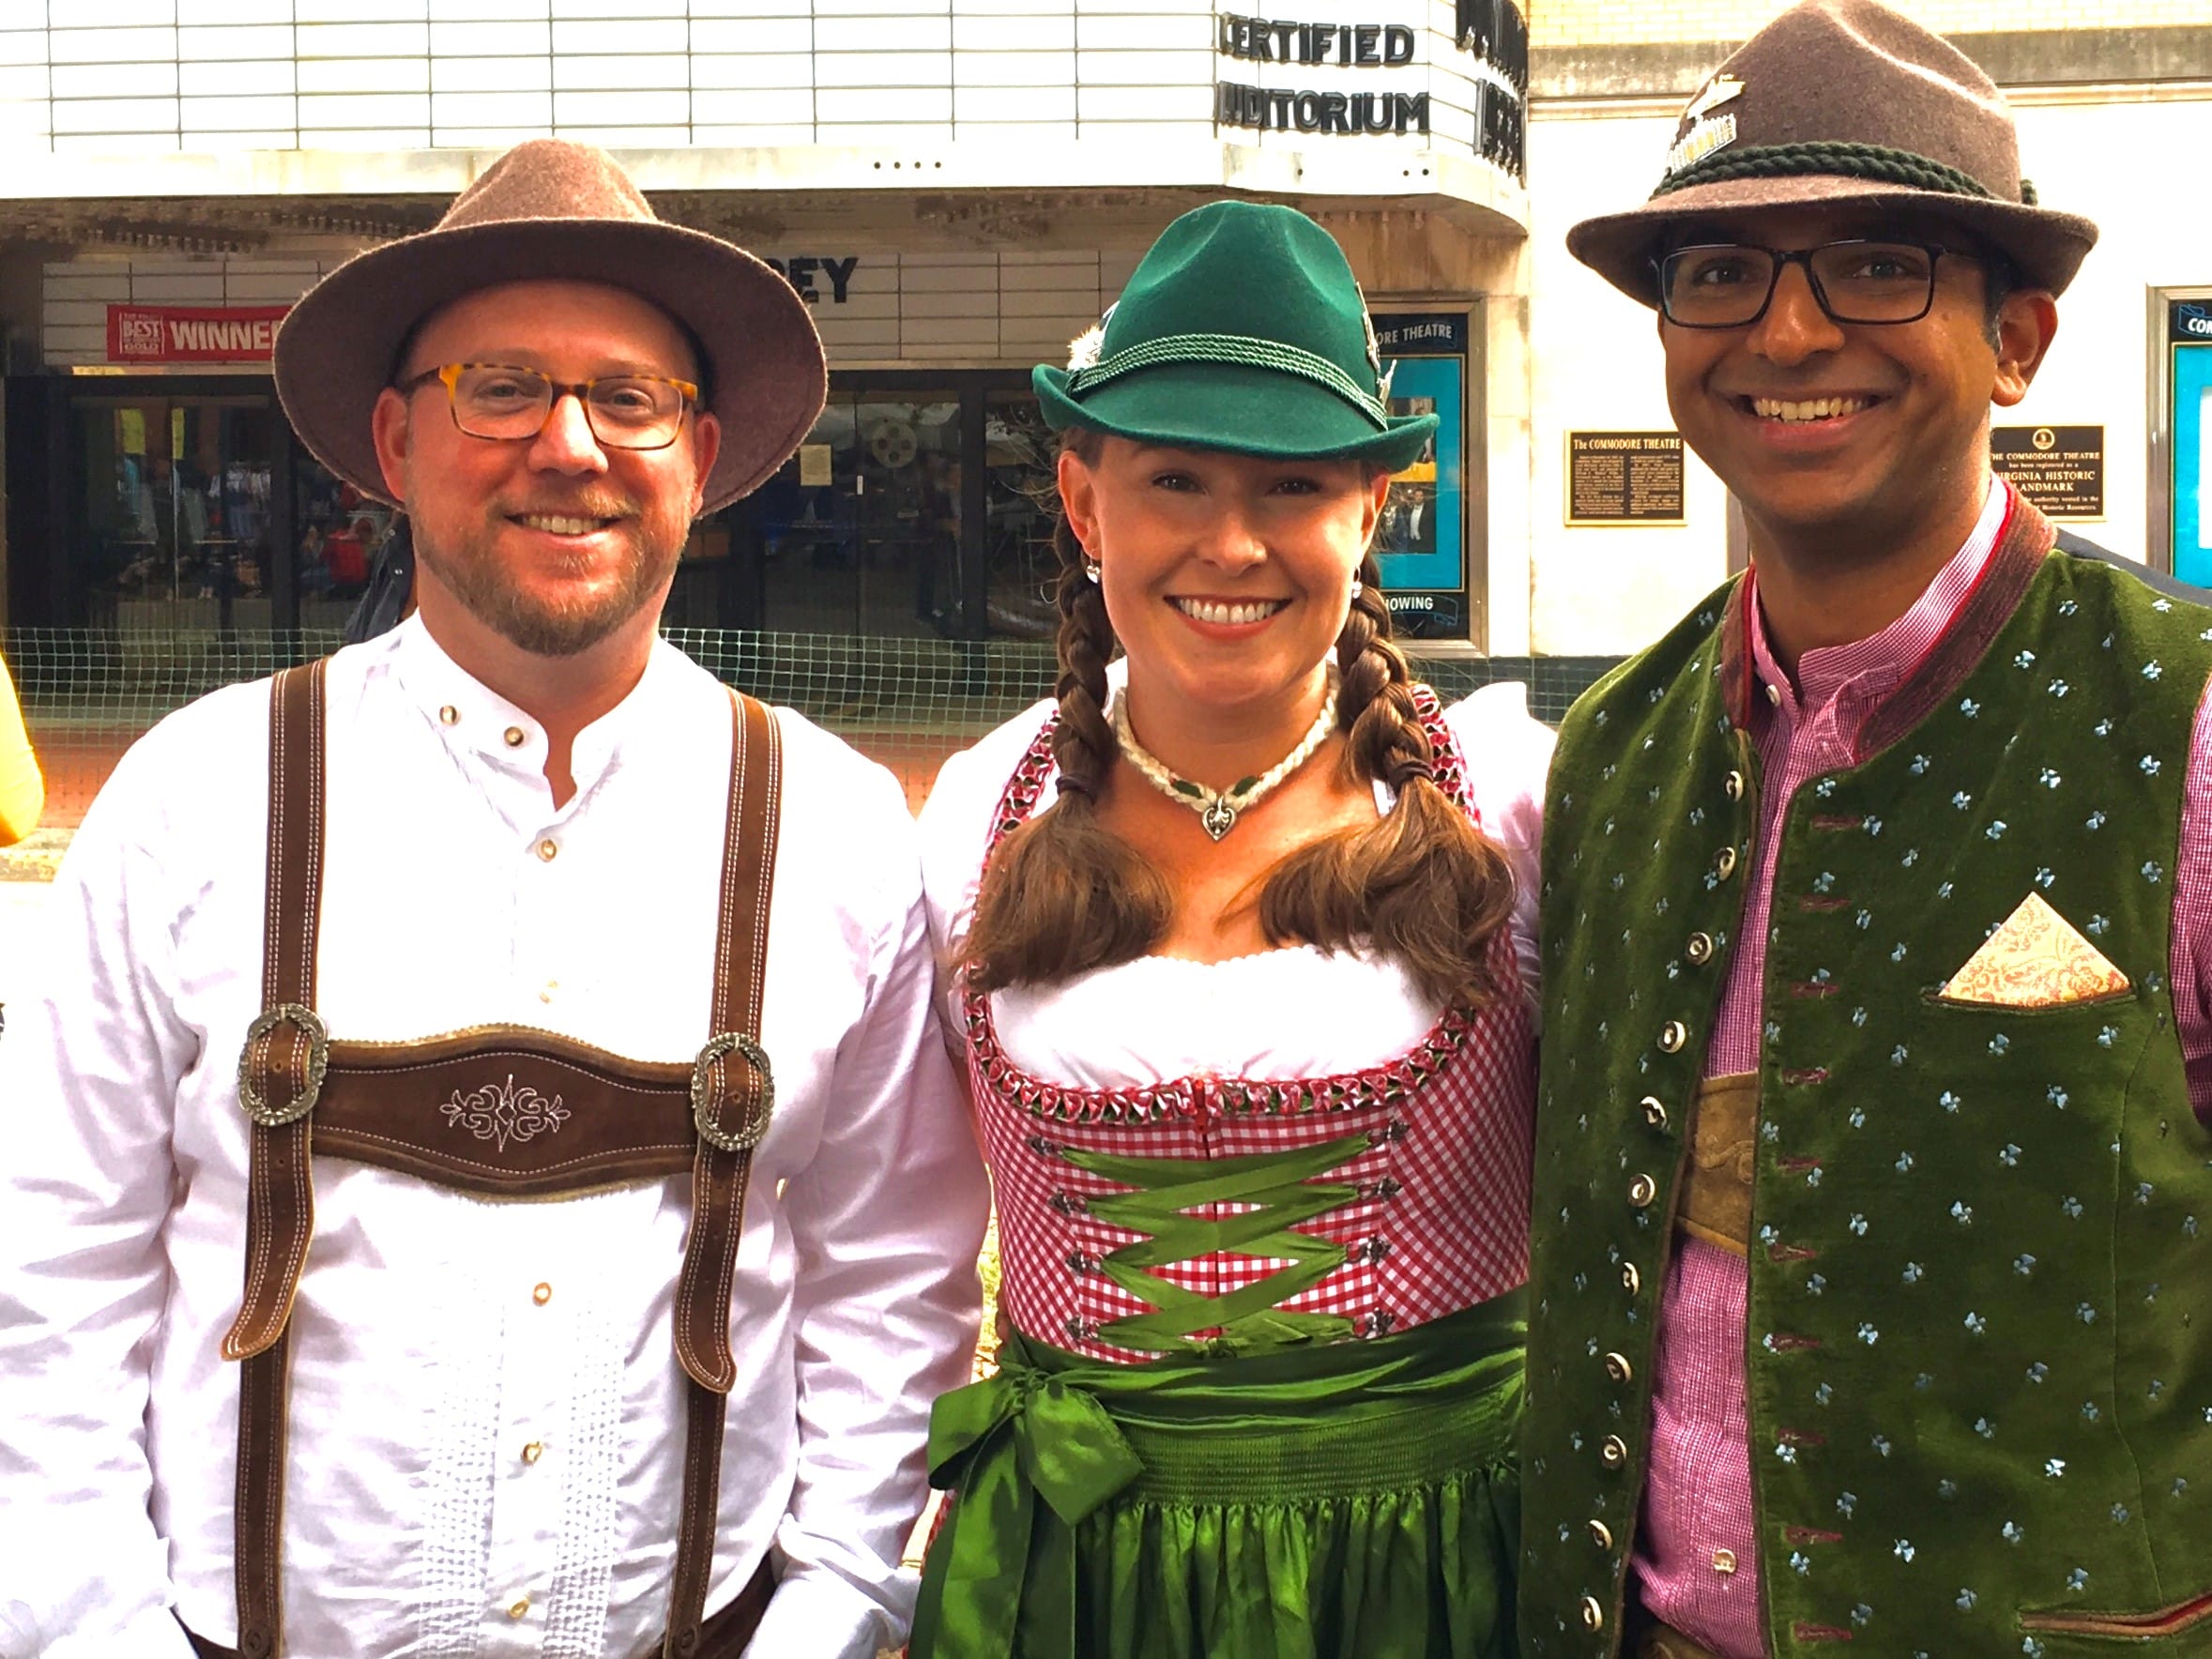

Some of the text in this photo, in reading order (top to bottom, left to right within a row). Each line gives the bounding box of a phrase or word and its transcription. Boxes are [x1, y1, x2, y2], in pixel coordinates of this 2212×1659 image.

[1221, 11, 1415, 67] CERTIFIED
[1219, 80, 1429, 136] UDITORIUM
[123, 320, 160, 338] BEST
[1402, 323, 1453, 342] THEATRE
[1574, 438, 1681, 449] The COMMODORE THEATRE
[2006, 452, 2060, 461] COMMODORE
[2045, 470, 2096, 480] HISTORIC
